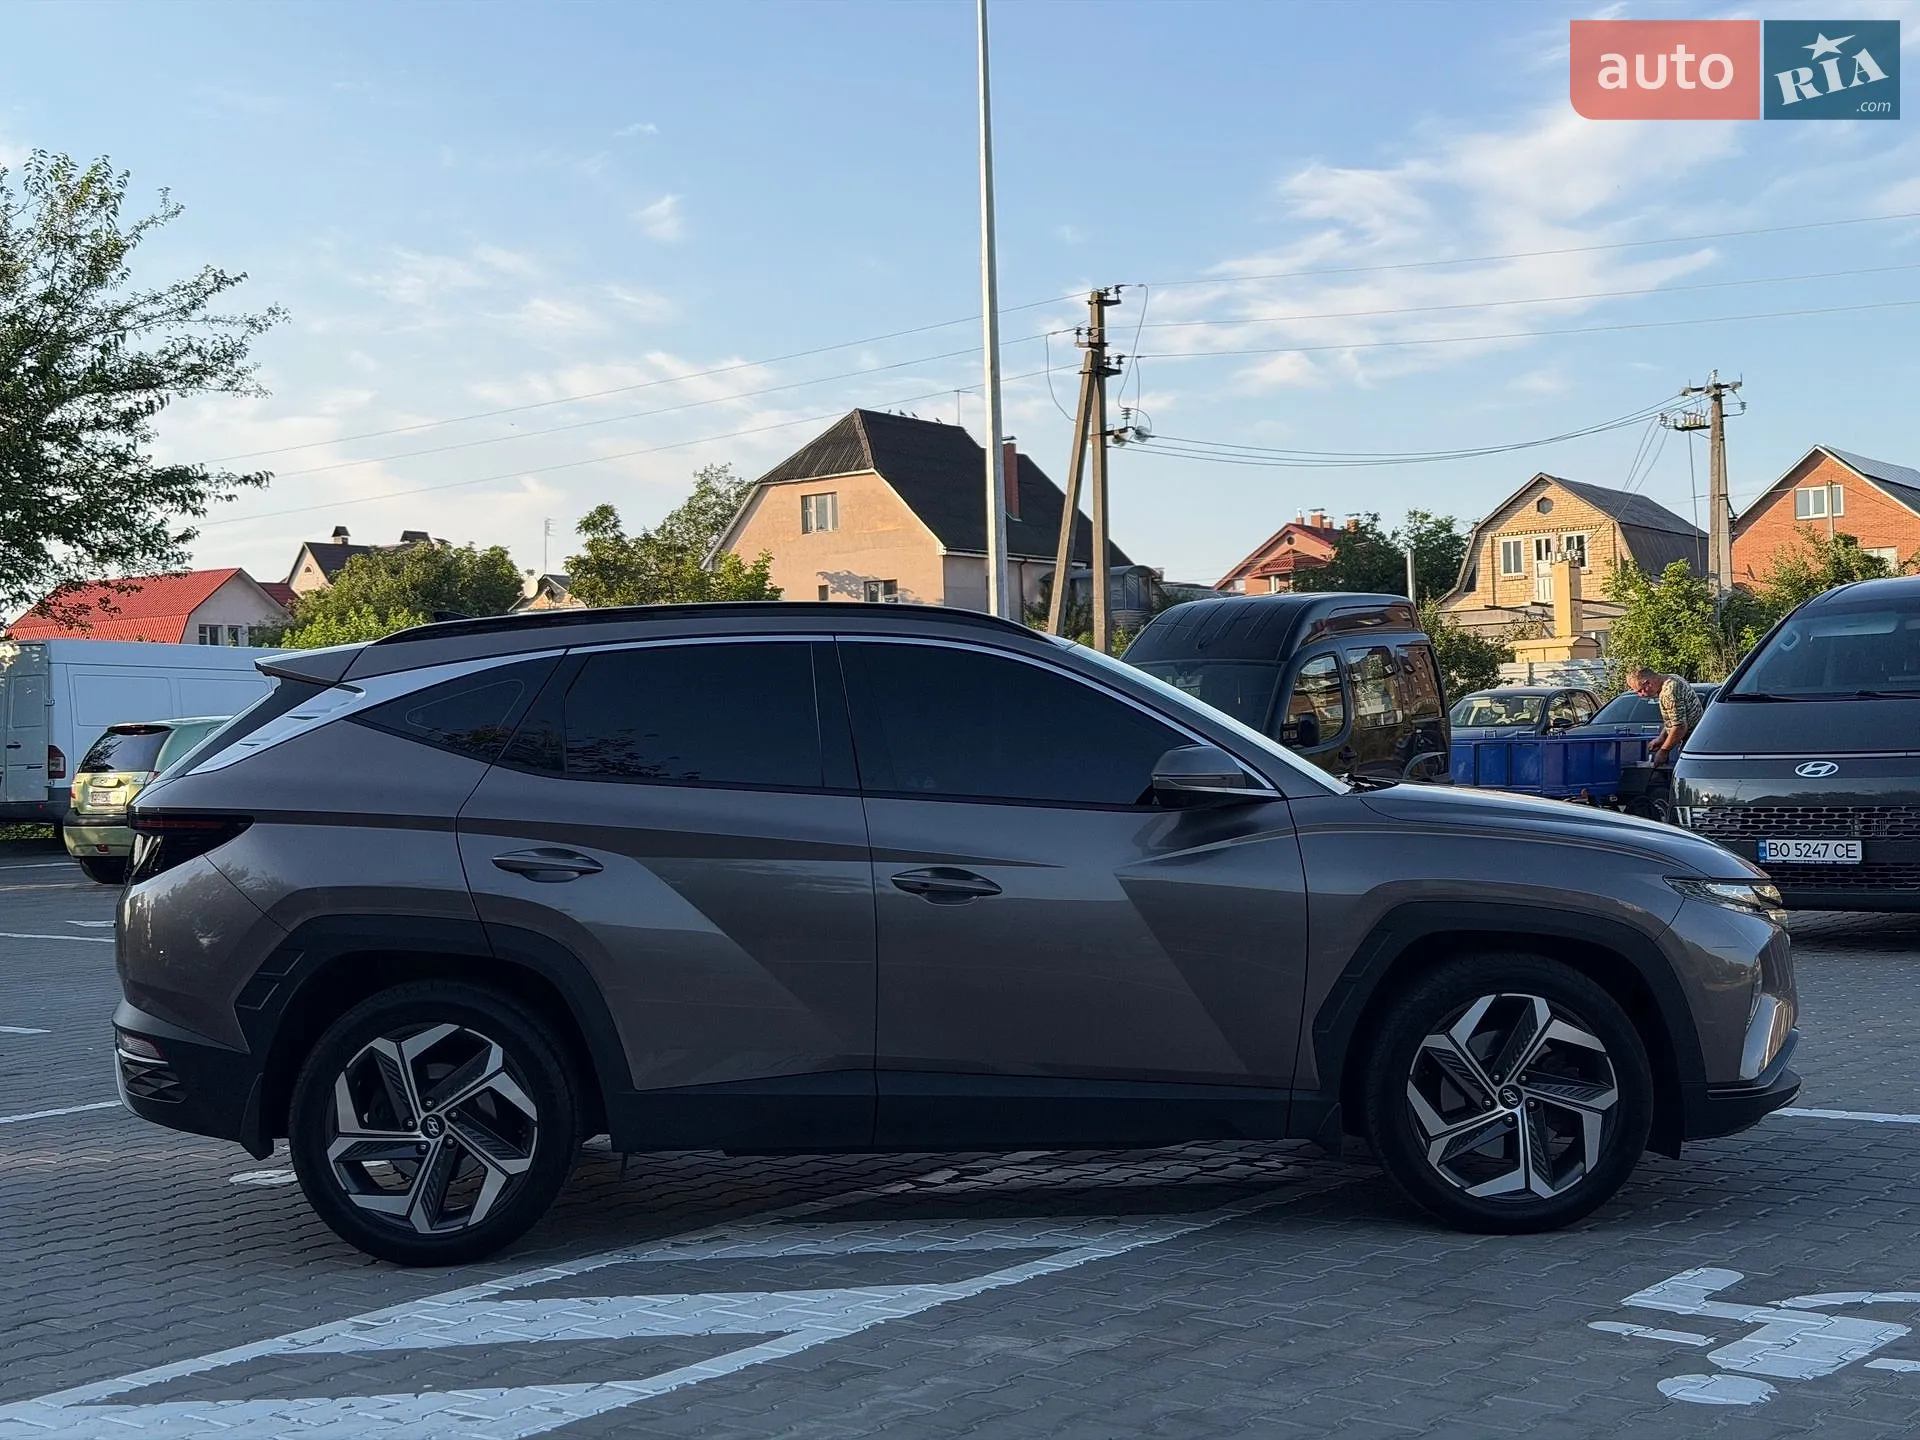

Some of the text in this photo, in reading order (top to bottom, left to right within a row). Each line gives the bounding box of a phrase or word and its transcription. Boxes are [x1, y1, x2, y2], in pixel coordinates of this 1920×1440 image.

[1768, 842, 1791, 858] BO
[1794, 843, 1830, 858] 5247
[1833, 843, 1858, 859] CE
